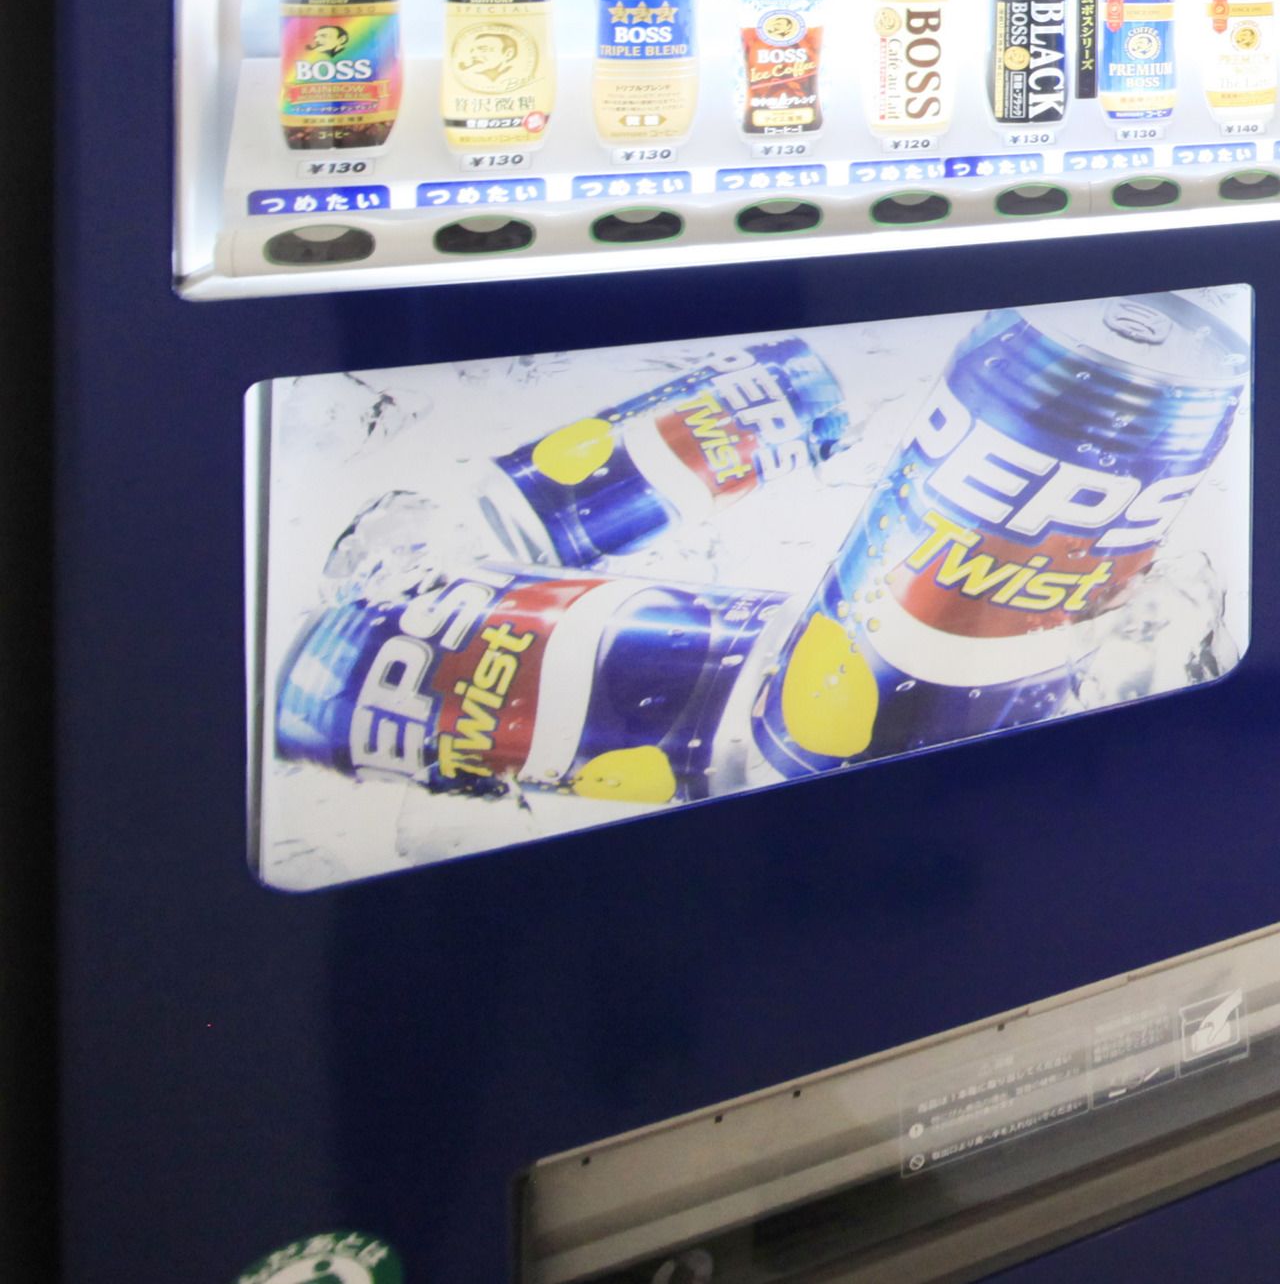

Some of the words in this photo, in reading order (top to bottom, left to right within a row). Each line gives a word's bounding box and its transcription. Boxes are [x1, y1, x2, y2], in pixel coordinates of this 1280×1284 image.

[1010, 1, 1029, 47] BOSS
[613, 25, 674, 45] BOSS
[599, 43, 642, 58] TRIPLE
[645, 42, 689, 57] BLEND
[757, 47, 809, 66] BOSS
[1028, 0, 1065, 121] BLACK
[295, 59, 372, 82] BOSS
[749, 66, 769, 83] Ice
[771, 60, 818, 82] Coffee
[905, 7, 942, 121] BOSS
[1108, 62, 1174, 77] PREMIUM
[1125, 76, 1161, 90] BOSS
[317, 130, 351, 141] コーヒー
[1225, 123, 1260, 134] ¥140
[889, 138, 931, 151] ¥120
[675, 389, 755, 487] Twist
[902, 512, 1116, 616] Twist
[437, 621, 536, 781] Twist
